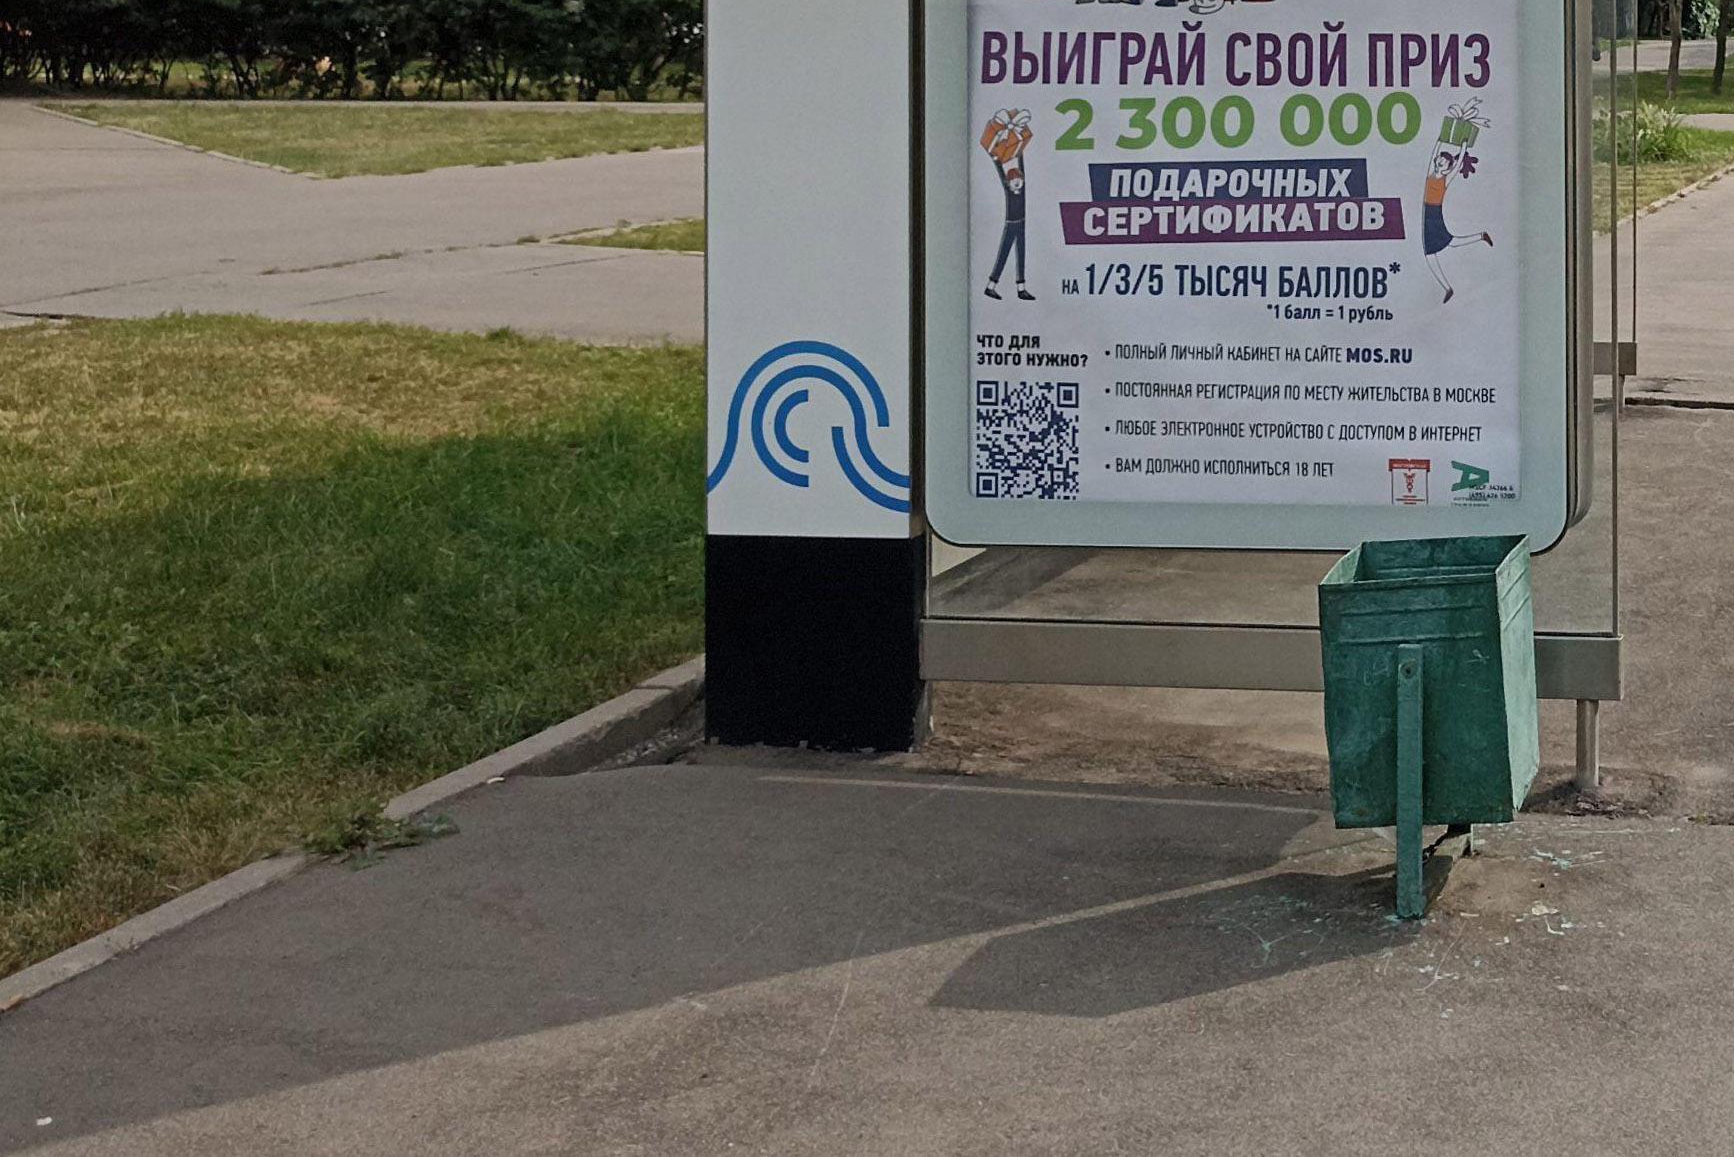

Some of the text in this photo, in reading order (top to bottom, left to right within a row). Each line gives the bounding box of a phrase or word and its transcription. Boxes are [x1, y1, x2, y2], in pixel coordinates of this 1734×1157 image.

[981, 21, 1491, 88] ВЫИГРАЙ СВОЙ ПРИЗ
[1054, 92, 1422, 151] 2 300 000
[1109, 168, 1352, 201] ПОДАРОЧНЫХ
[1083, 201, 1385, 236] СЕРТИФИКАТОВ
[1085, 262, 1164, 296] 1/3/5
[1174, 264, 1268, 297] ТЫСЯЧ
[1284, 304, 1321, 320] балл
[1338, 305, 1345, 321] 1
[1348, 305, 1394, 324] рубль
[976, 334, 1041, 351] ЧТО ДЛЯ
[1115, 343, 1413, 364] ПОЛНЫЙ ЛИЧНЫЙ КАБИНЕТ НА САЙТЕ MOS.RU
[976, 352, 1088, 368] ЭТОГО НУЖНО?
[1115, 381, 1497, 404] ПОСТОЯННАЯ РЕГИСТРАЦИЯ ПО МЕСТУ ЖИТЕЛЬСТВА В МОСКВЕ
[1115, 420, 1482, 442] ЛЮБОЕ ЭЛЕКТРОННОЕ УСТРОЙСТВО С ДОСТУПОМ В ИНТЕРНЕТ
[1115, 457, 1334, 478] ВАМ ДОЛЖНО ИСПОЛНИТЬСЯ 18 ЛЕТ
